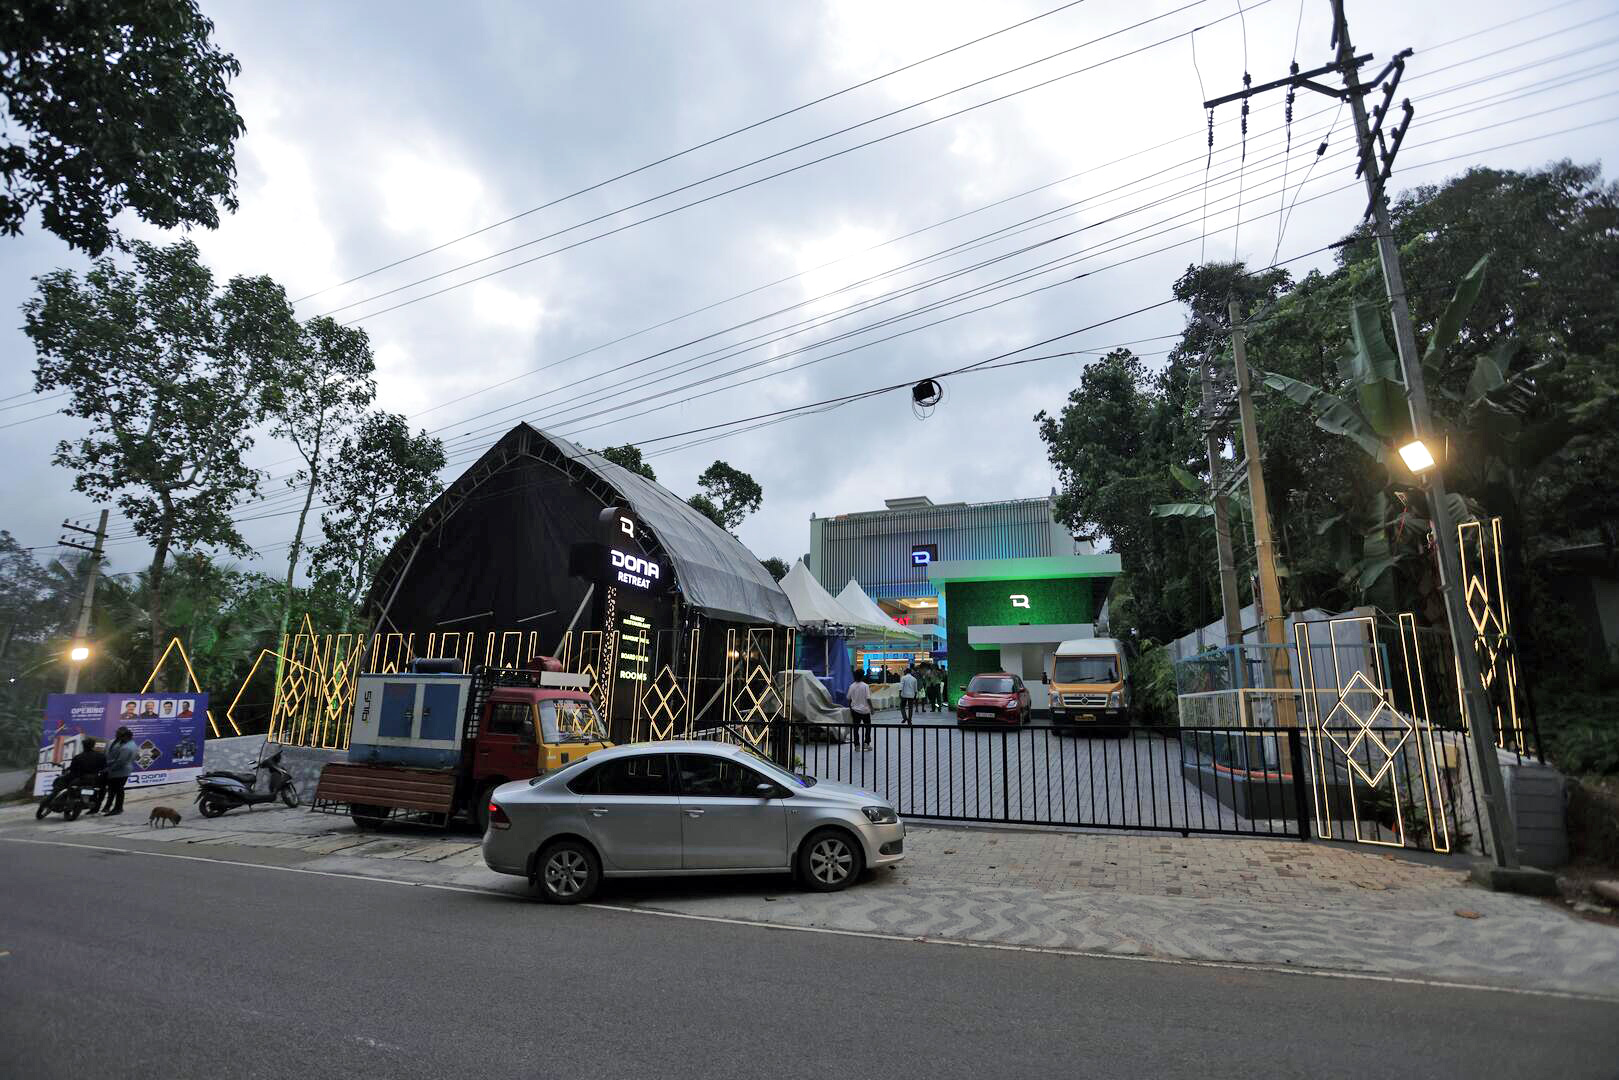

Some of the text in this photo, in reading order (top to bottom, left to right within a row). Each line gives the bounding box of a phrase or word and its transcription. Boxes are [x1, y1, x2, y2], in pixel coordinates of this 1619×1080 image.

[611, 549, 659, 579] DONA
[617, 571, 651, 589] RETREAT
[620, 670, 648, 681] ROOMS
[141, 772, 168, 780] DONA
